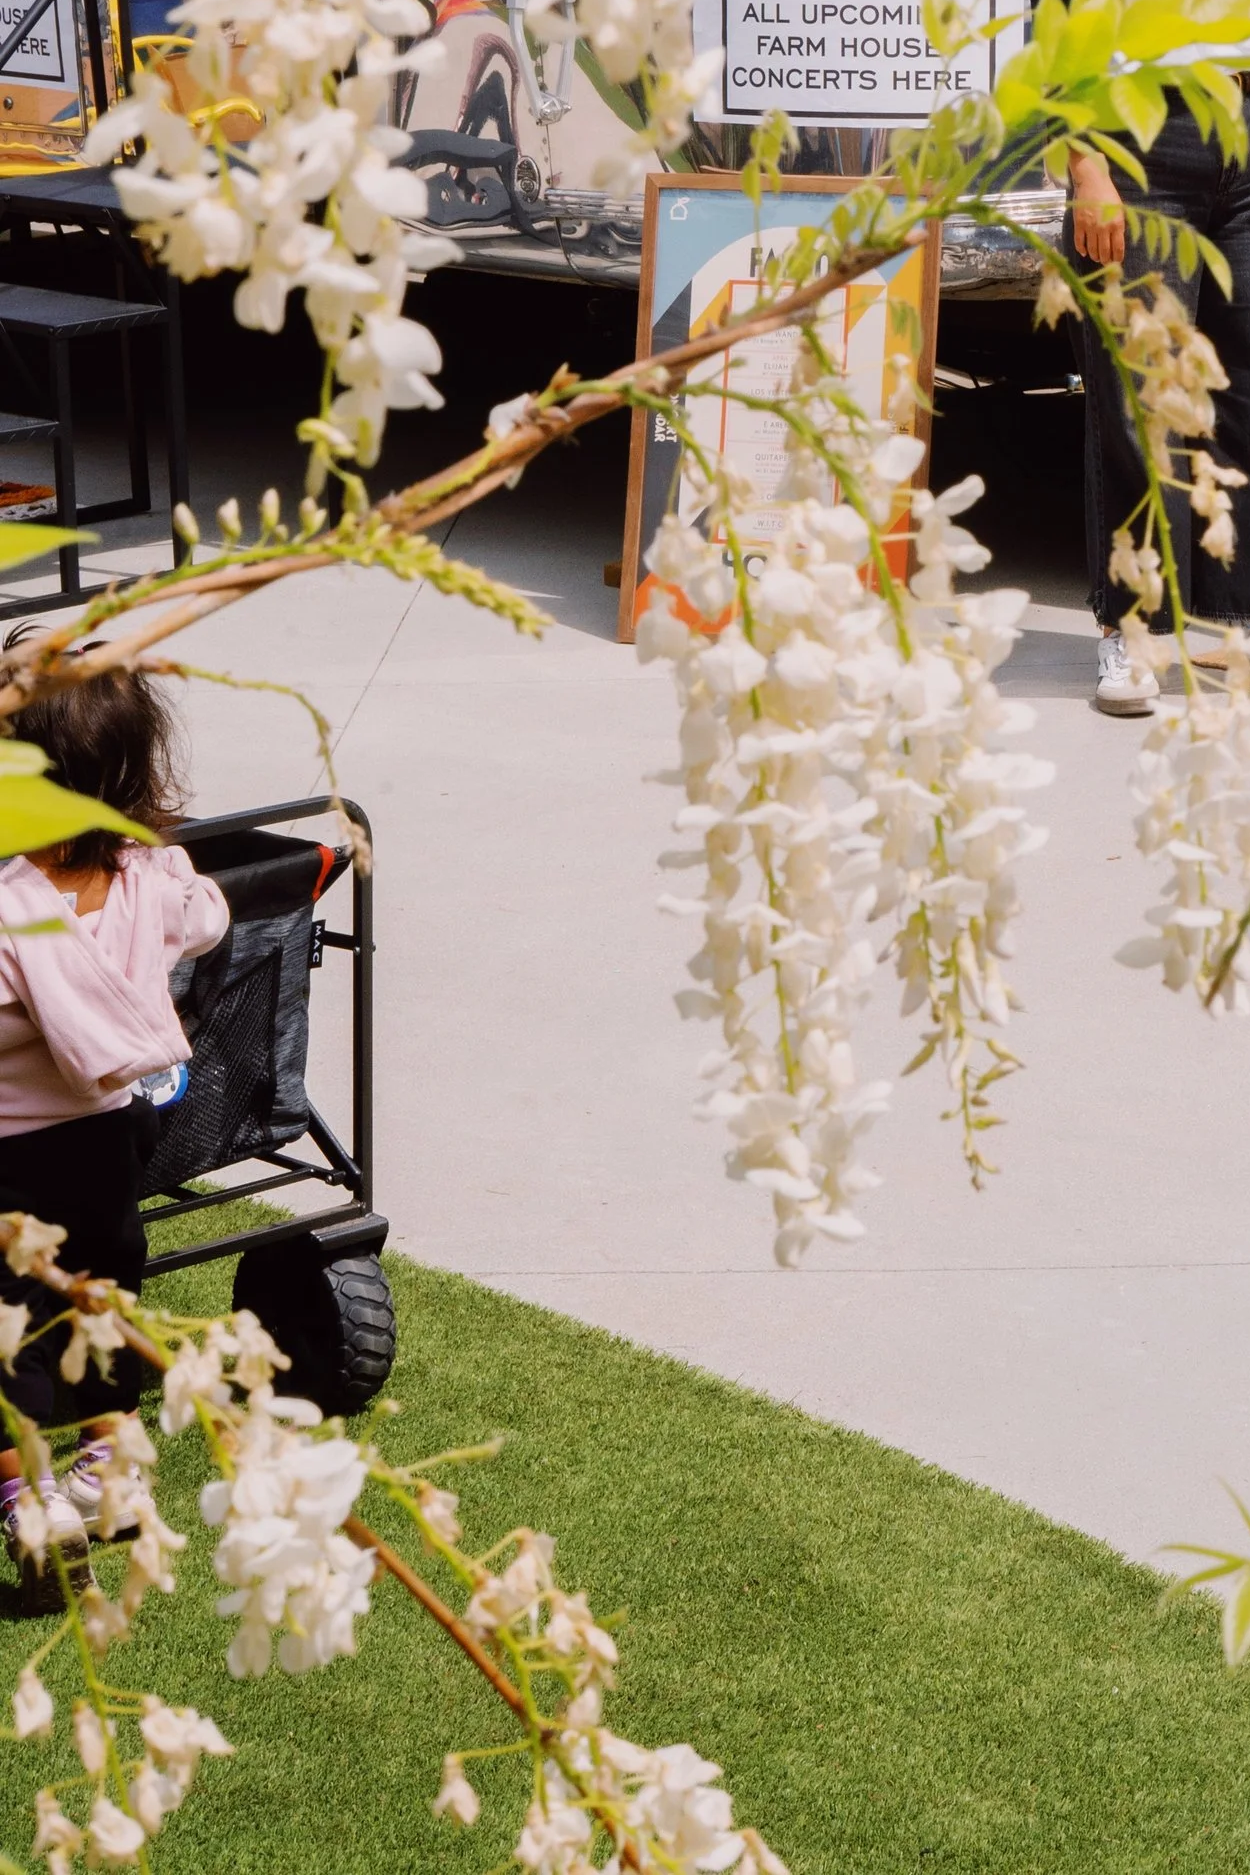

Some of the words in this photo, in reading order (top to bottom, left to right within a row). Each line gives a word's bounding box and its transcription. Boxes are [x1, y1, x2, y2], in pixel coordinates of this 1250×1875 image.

[742, 2, 790, 24] ALL
[802, 4, 922, 26] UPCOMI
[757, 35, 826, 57] FARM
[732, 67, 878, 90] CONCERTS
[893, 70, 972, 91] HERE
[312, 925, 322, 963] MAC
